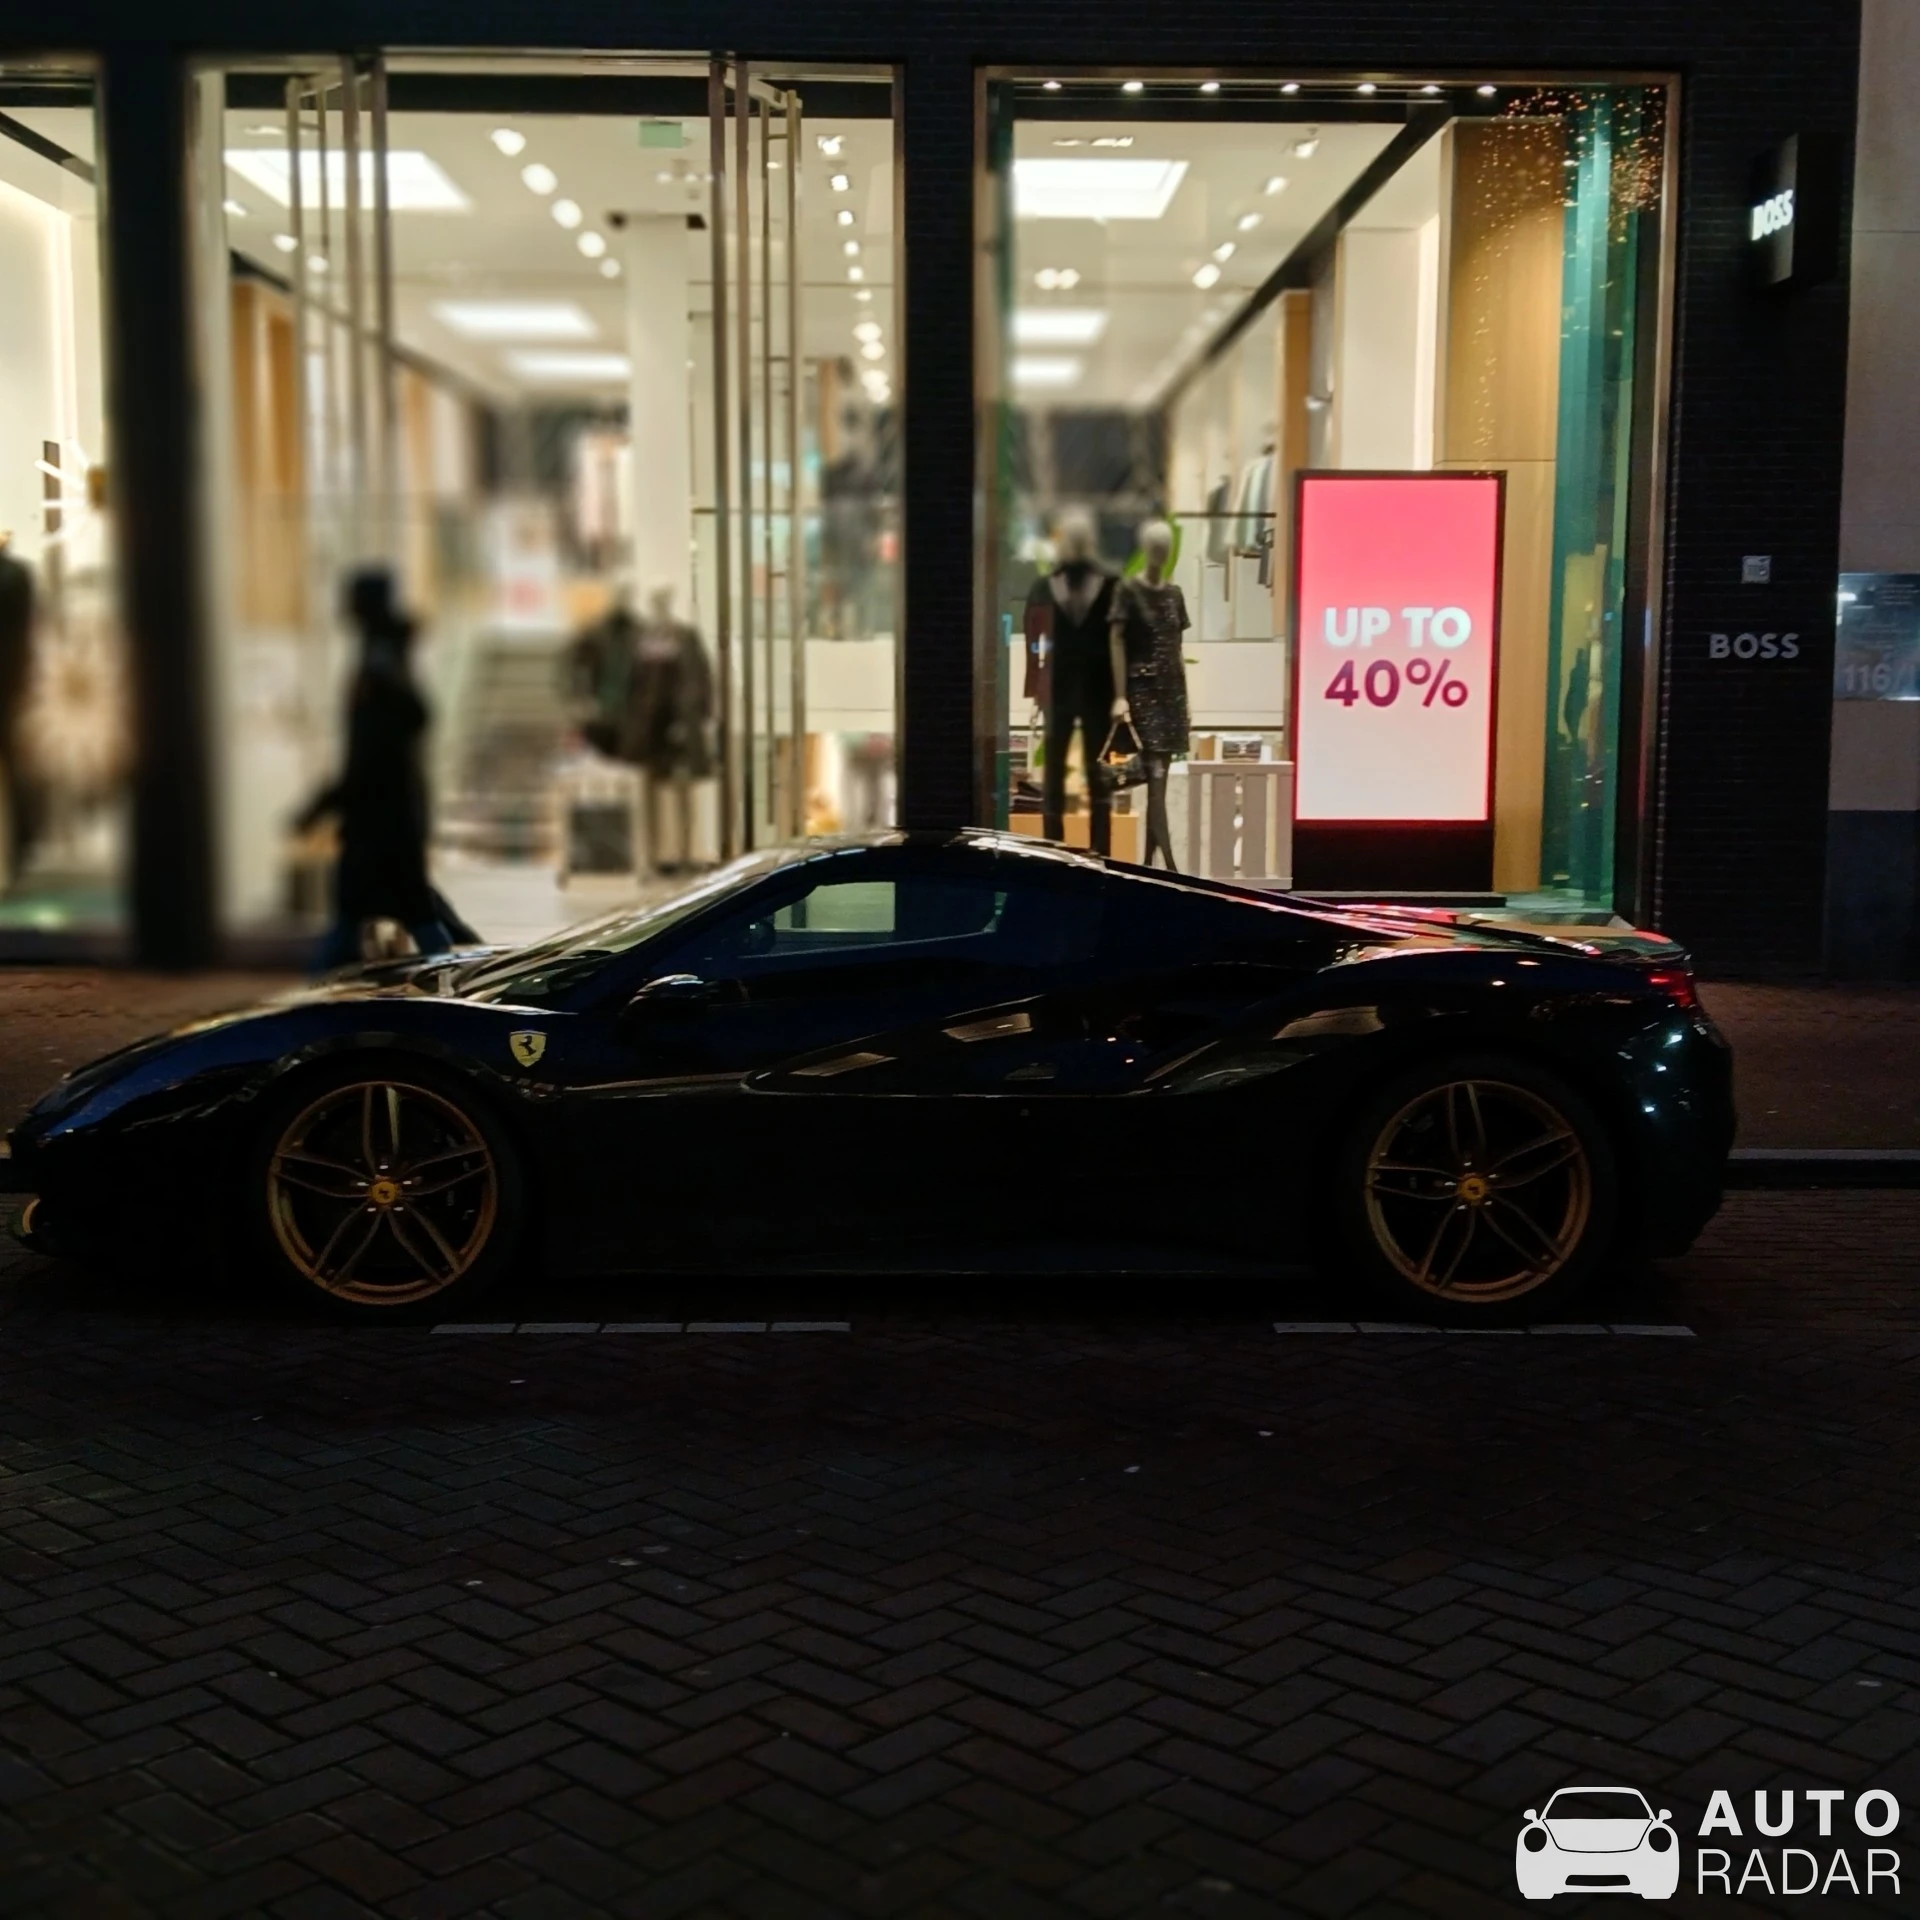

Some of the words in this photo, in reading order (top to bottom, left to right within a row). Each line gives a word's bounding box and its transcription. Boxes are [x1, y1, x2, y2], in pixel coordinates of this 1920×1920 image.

[1752, 189, 1793, 240] BOSS
[1325, 607, 1391, 647] UP
[1402, 607, 1471, 648] TO
[1709, 632, 1800, 660] BOSS
[1325, 657, 1468, 707] 40%
